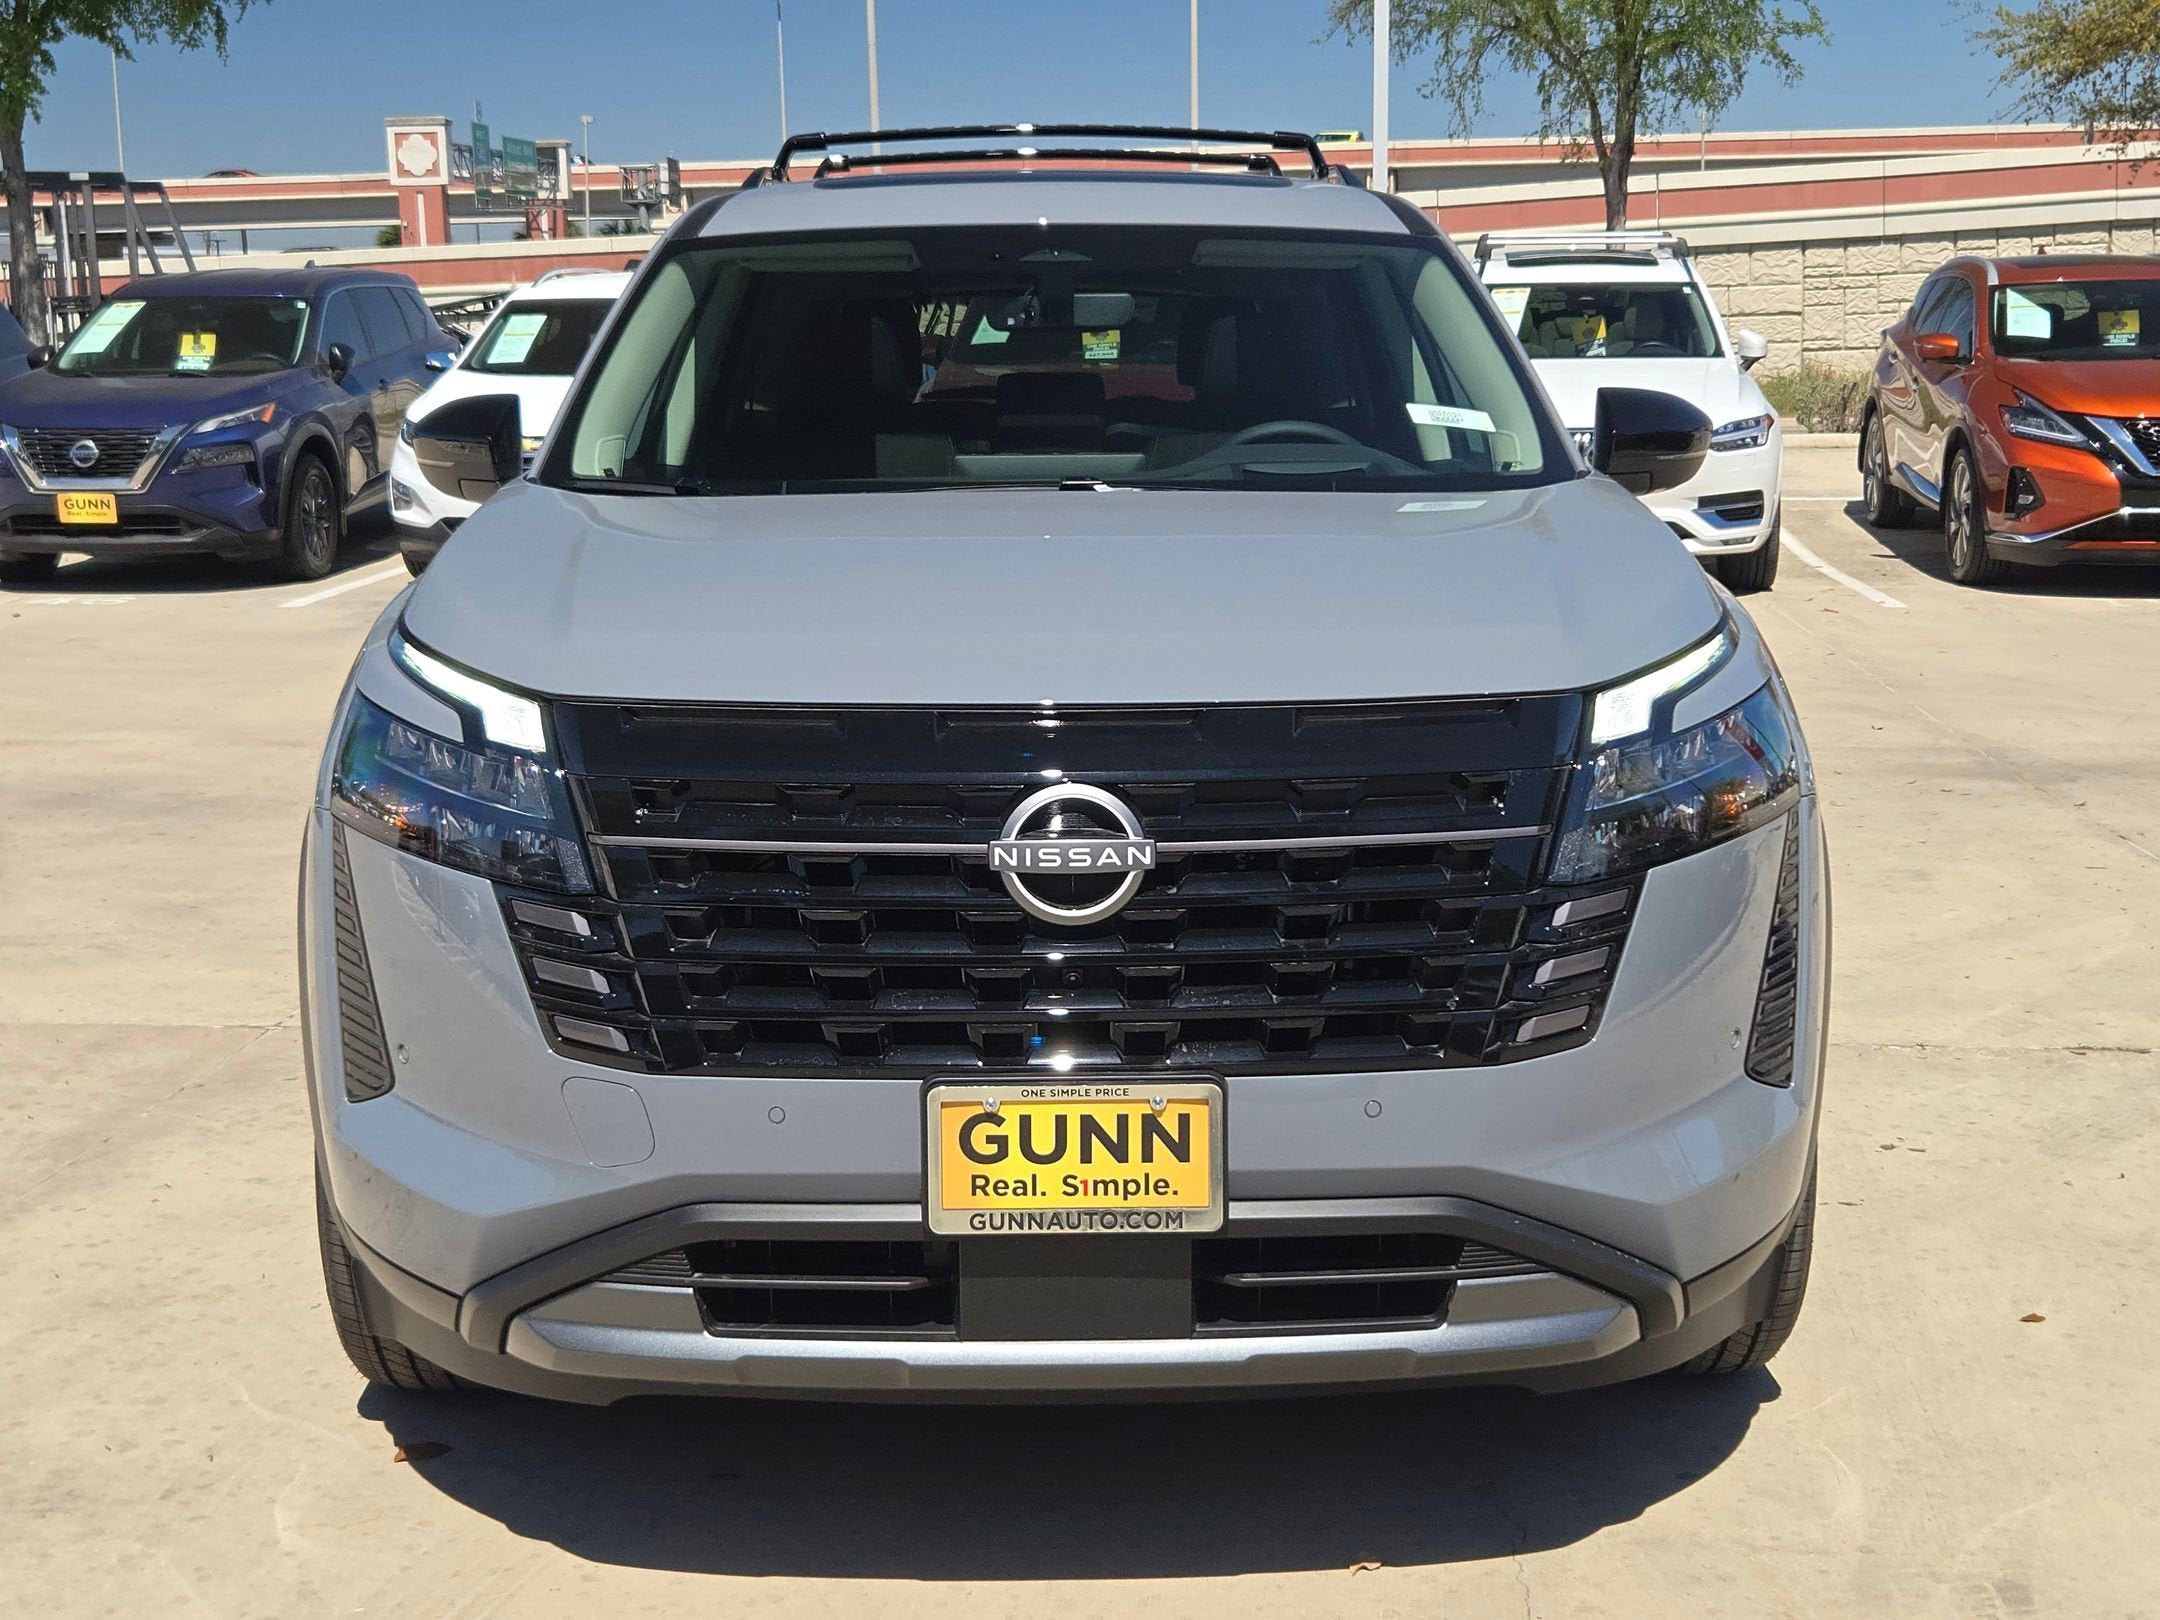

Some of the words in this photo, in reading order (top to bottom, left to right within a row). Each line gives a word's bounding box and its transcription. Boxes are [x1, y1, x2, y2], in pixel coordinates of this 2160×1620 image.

[64, 498, 111, 510] GUNN
[994, 846, 1151, 867] NISSAN
[1021, 1088, 1046, 1098] ONE
[1050, 1088, 1092, 1098] SIMPLE
[1095, 1087, 1129, 1097] PRICE
[958, 1113, 1191, 1164] GUNN
[971, 1174, 1047, 1197] Real.
[969, 1211, 1184, 1231] GUNNAUTO.COM
